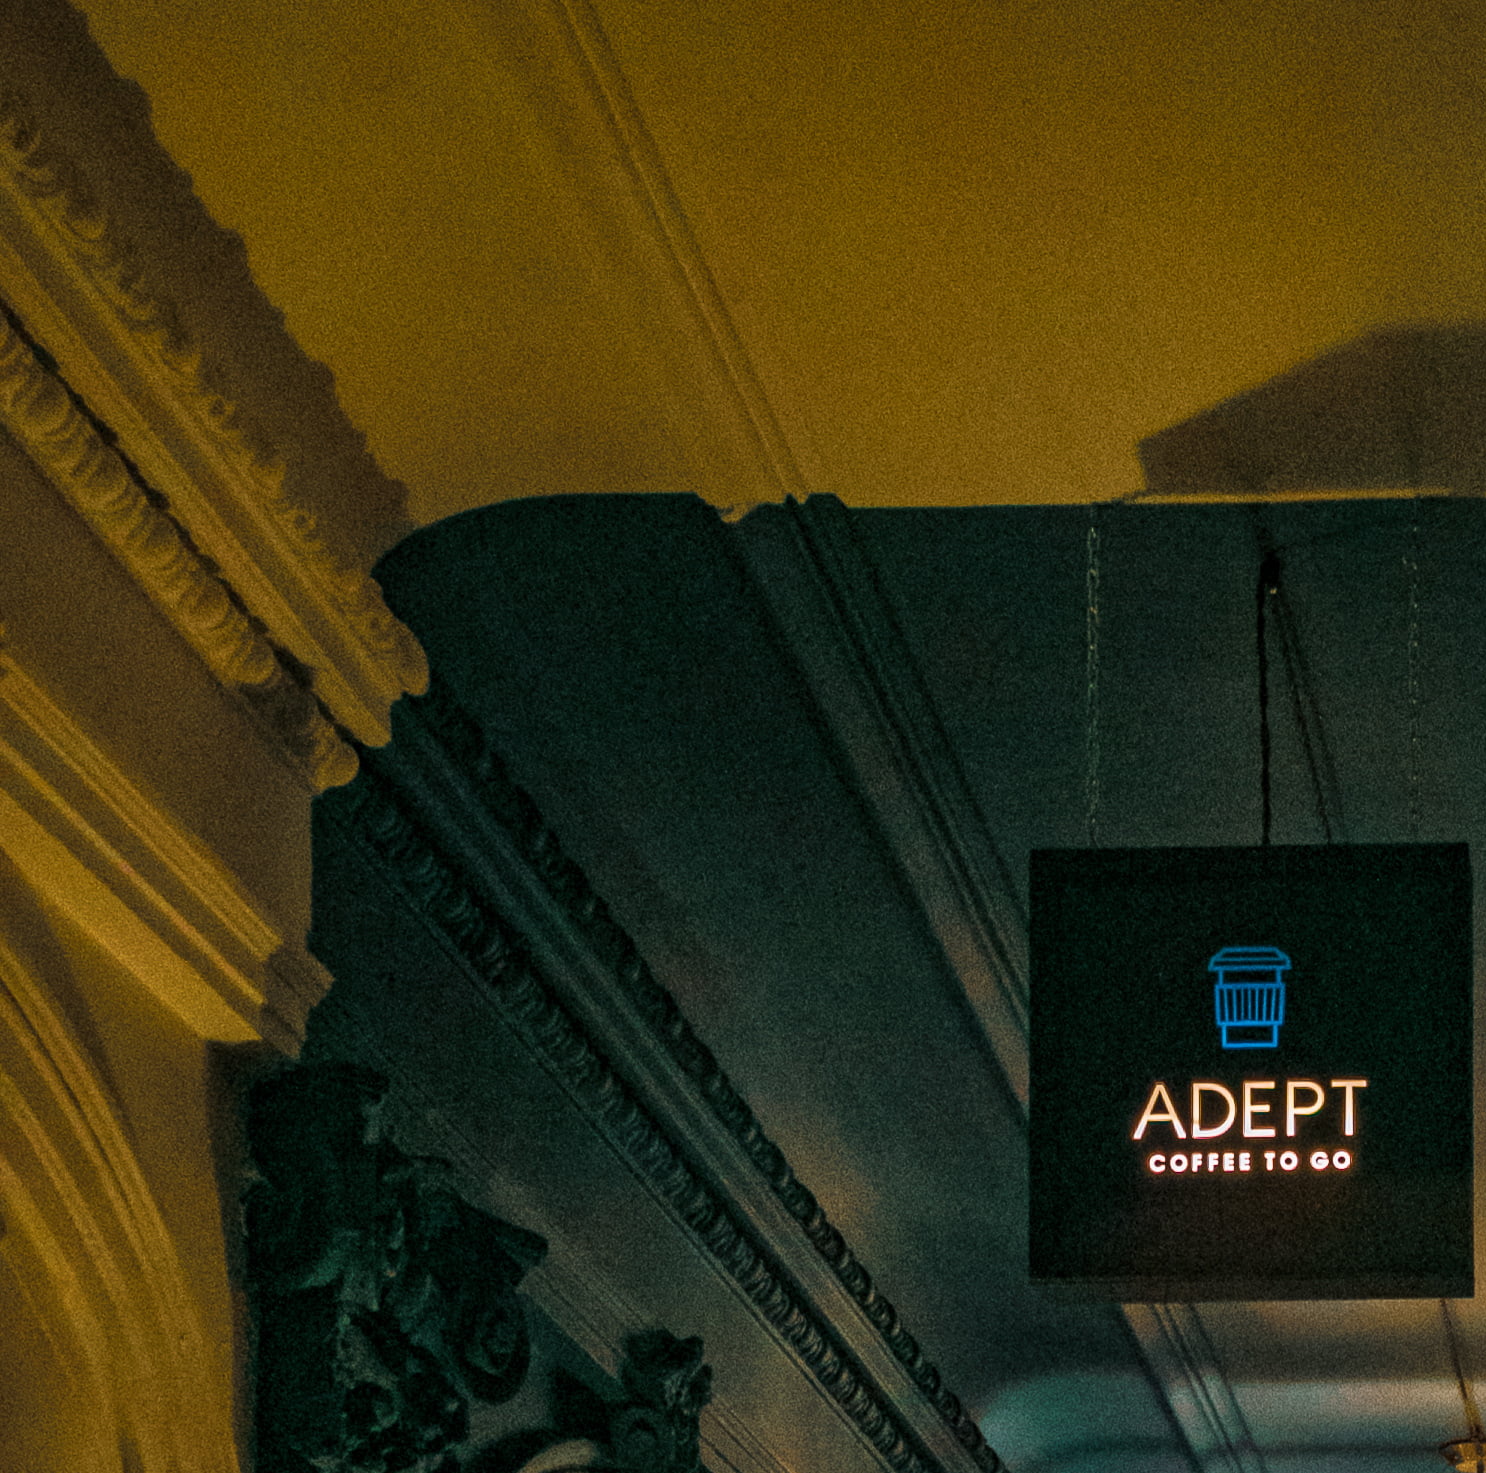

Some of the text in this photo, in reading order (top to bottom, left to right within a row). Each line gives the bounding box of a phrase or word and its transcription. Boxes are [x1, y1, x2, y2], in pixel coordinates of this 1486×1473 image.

[1132, 1079, 1368, 1140] ADEPT
[1148, 1149, 1352, 1174] COFFEE TO GO
